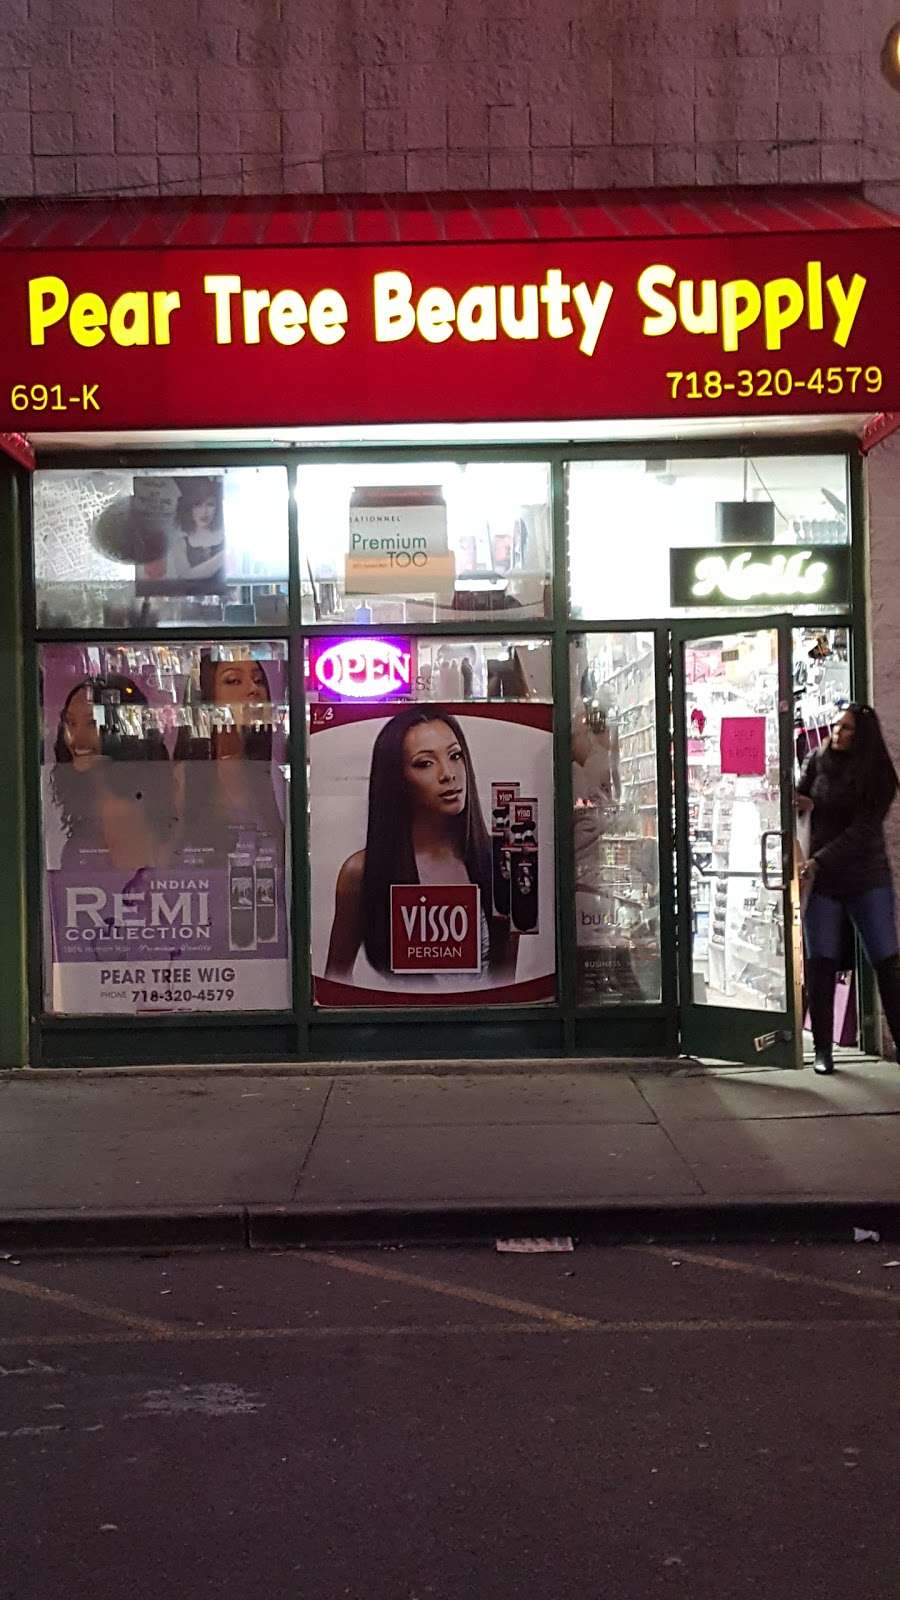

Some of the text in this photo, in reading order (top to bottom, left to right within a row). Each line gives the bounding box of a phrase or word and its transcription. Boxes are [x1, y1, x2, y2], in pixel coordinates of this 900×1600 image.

[28, 261, 867, 357] Pear Tree Beauty Supply
[666, 366, 883, 400] 718-320-4579
[10, 384, 101, 412] 691-K
[351, 533, 428, 550] Premium
[386, 551, 428, 568] TOO
[691, 551, 829, 601] Nails
[315, 652, 411, 684] OPEN
[151, 880, 210, 890] INDIAN
[65, 887, 211, 928] REMI
[65, 927, 211, 942] COLLECTION
[407, 946, 462, 959] PERSIAN
[100, 967, 236, 985] PEAR TREE WIG
[131, 988, 235, 1003] 718-320-4579
